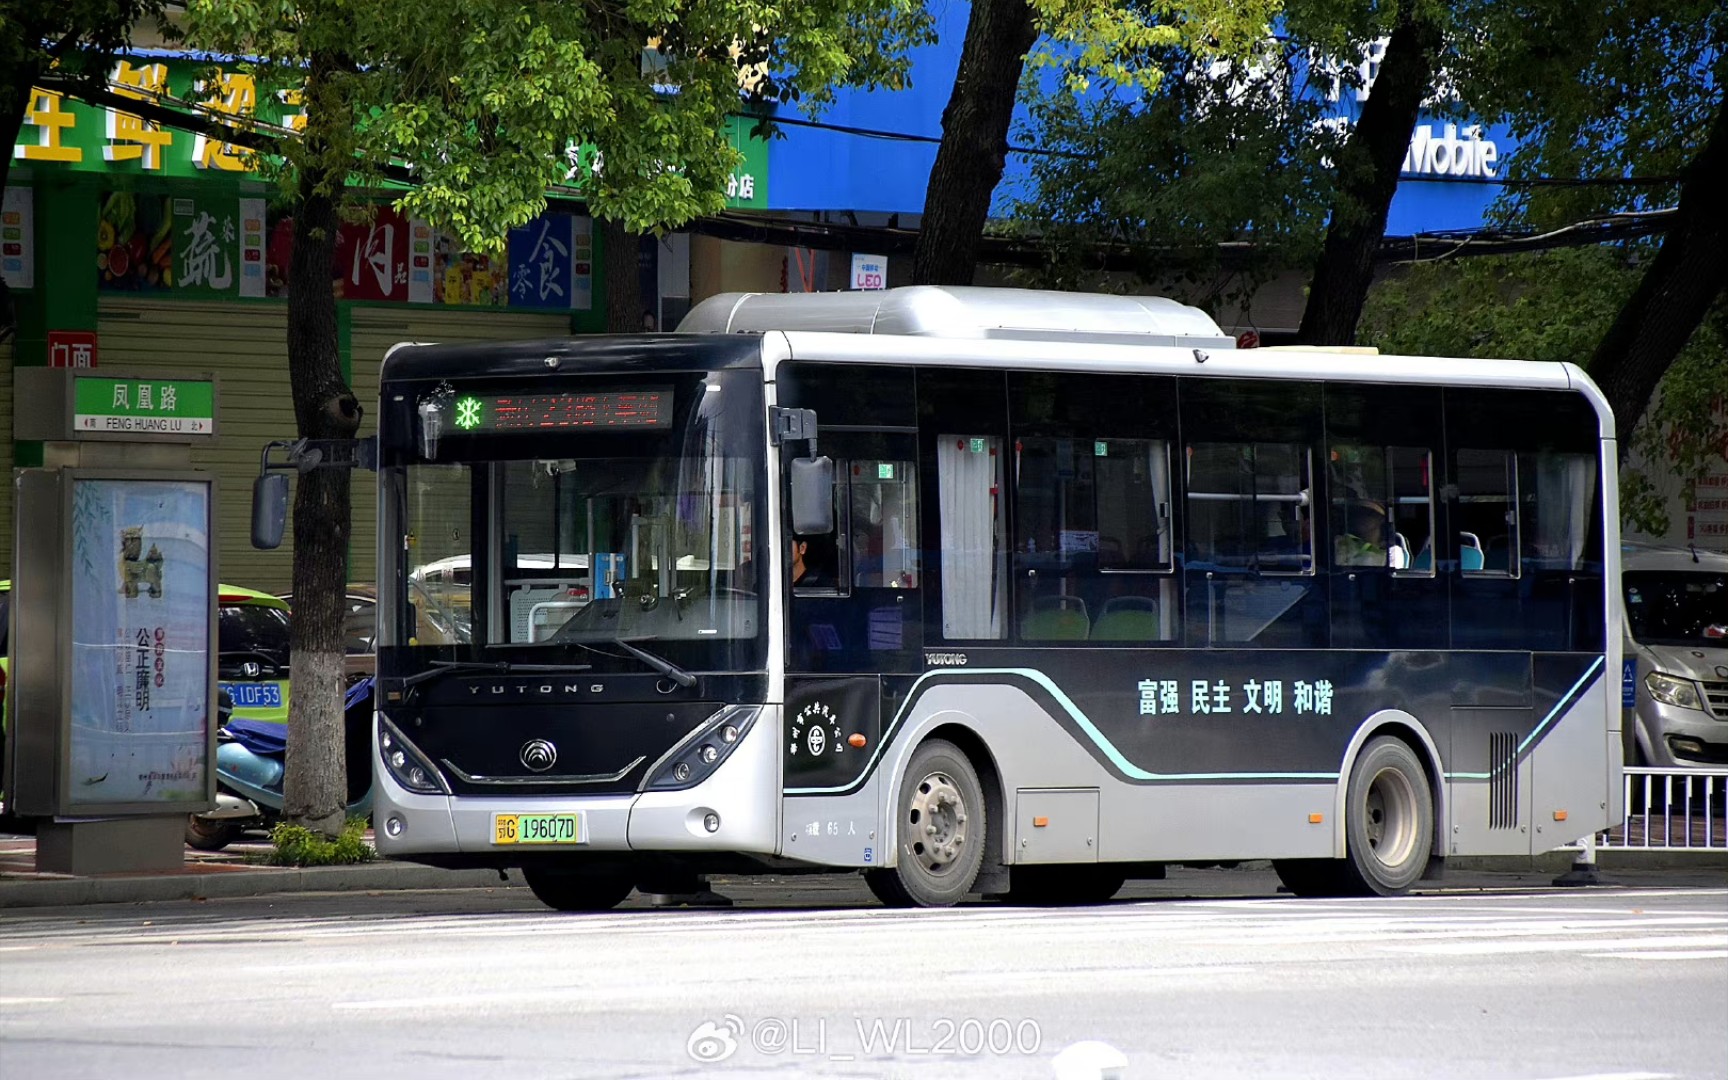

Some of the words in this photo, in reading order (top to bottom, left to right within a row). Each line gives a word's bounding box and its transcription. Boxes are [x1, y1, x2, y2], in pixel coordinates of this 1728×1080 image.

[14, 60, 308, 170] 生鲜超
[856, 274, 882, 288] LED
[112, 384, 177, 411] 凤凰路
[106, 417, 132, 430] FENG
[135, 419, 167, 431] HUANG
[170, 420, 182, 431] LU
[926, 653, 968, 666] YUTONG
[135, 627, 150, 711] 公正廉明
[469, 684, 605, 694] YUTONG
[1138, 679, 1180, 715] 富强
[1191, 680, 1232, 714] 民主
[1243, 679, 1283, 714] 文明
[1294, 680, 1334, 714] 和谐
[827, 821, 839, 835] 65
[847, 820, 856, 835] 人
